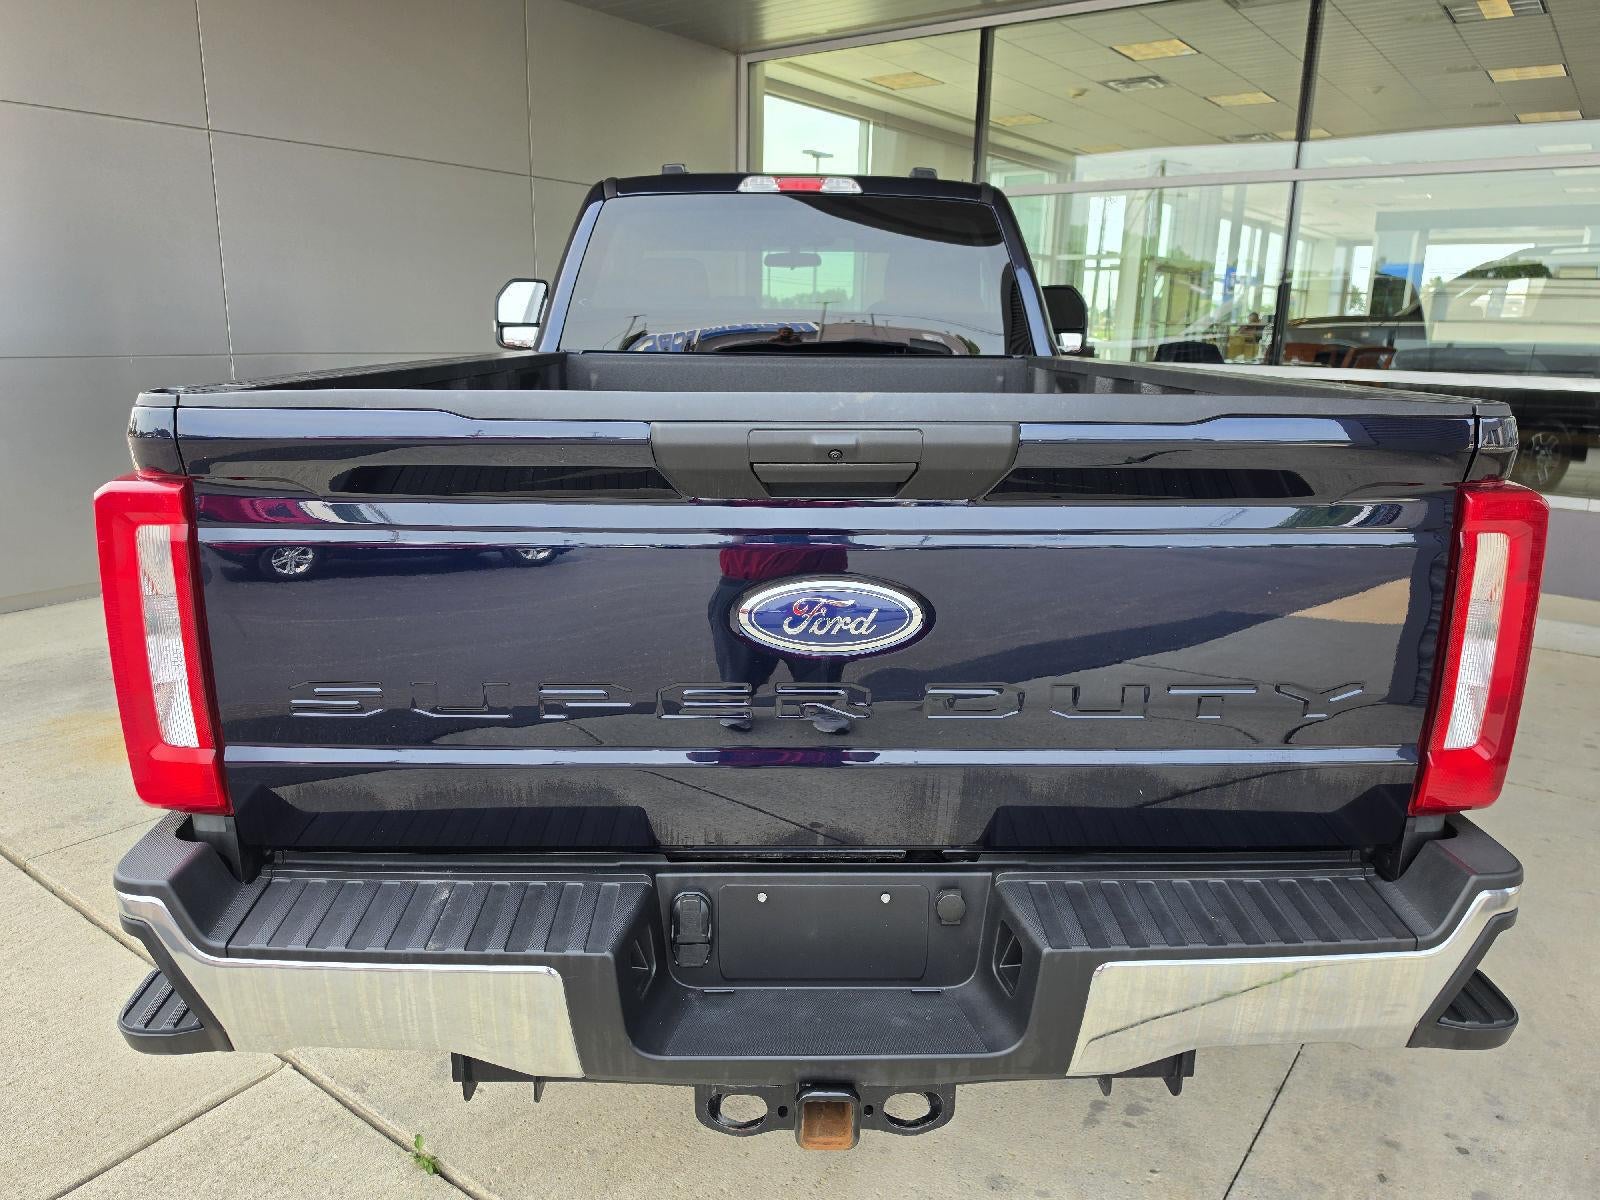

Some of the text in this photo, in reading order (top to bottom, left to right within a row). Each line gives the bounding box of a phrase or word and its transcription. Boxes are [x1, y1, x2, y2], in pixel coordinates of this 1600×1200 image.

[782, 597, 879, 635] Ford
[289, 680, 1366, 720] SUPER DUTY
